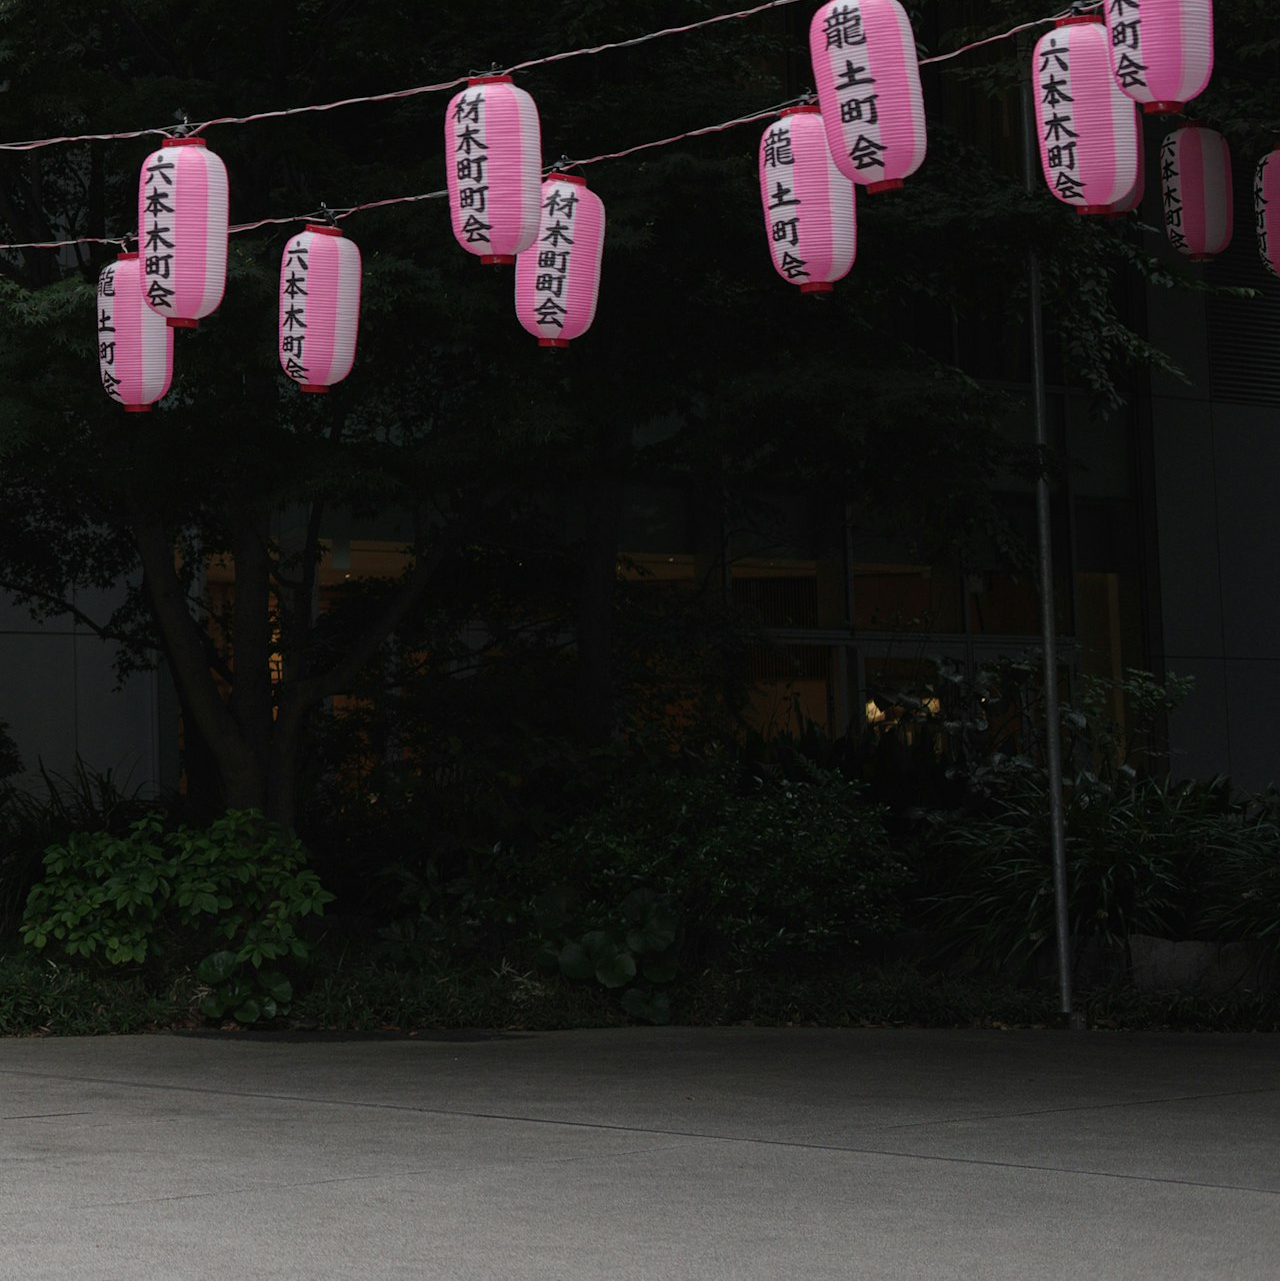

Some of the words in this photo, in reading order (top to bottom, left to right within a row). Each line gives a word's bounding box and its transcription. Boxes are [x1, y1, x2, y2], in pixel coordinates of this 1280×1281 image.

[821, 4, 888, 171] 龍土町会
[1039, 38, 1087, 201] 六本木町会
[144, 155, 175, 308] 六本木町会
[451, 92, 493, 244] 材木町町会
[762, 128, 810, 279] 龍土町会
[1161, 137, 1188, 250] 六本木町会
[98, 267, 122, 397] 龍土町会
[282, 241, 309, 380] 六本木町会
[533, 189, 580, 329] 材木町町会
